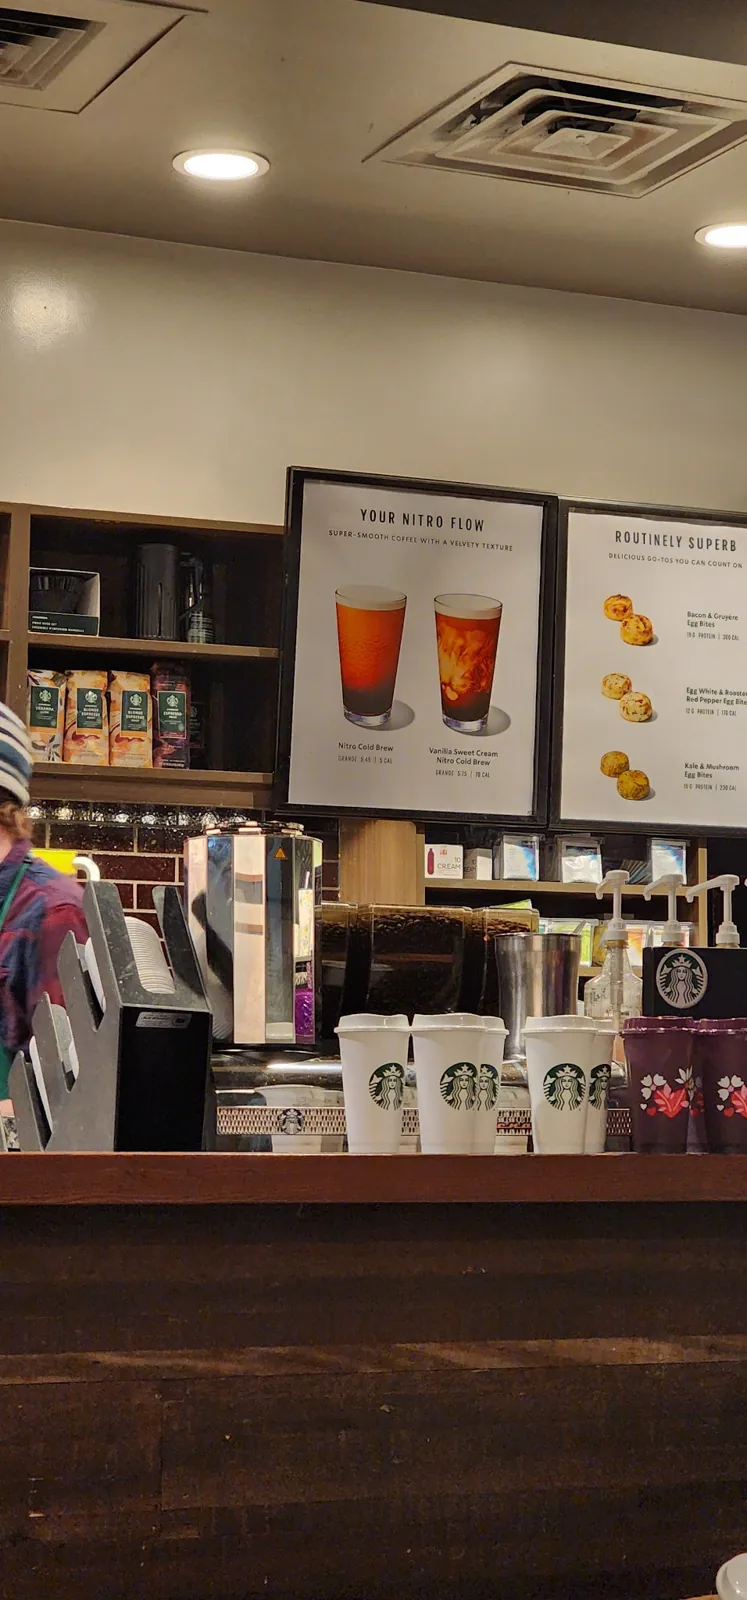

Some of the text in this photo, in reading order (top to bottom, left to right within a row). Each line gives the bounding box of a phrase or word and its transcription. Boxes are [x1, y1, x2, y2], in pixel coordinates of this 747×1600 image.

[360, 508, 484, 532] YOUR NITRO FLOW
[328, 530, 389, 540] SUPER-SMOOTH
[391, 534, 417, 543] COFFEE
[420, 537, 440, 545] WITH
[450, 540, 479, 548] VELVETY
[482, 543, 512, 552] TEXTURE
[615, 530, 736, 552] ROUTINELY SUPERB
[608, 553, 645, 561] DELICIOUS
[647, 556, 673, 564] GO-TOS
[714, 613, 738, 621] Gruyère
[686, 687, 697, 695] Egg
